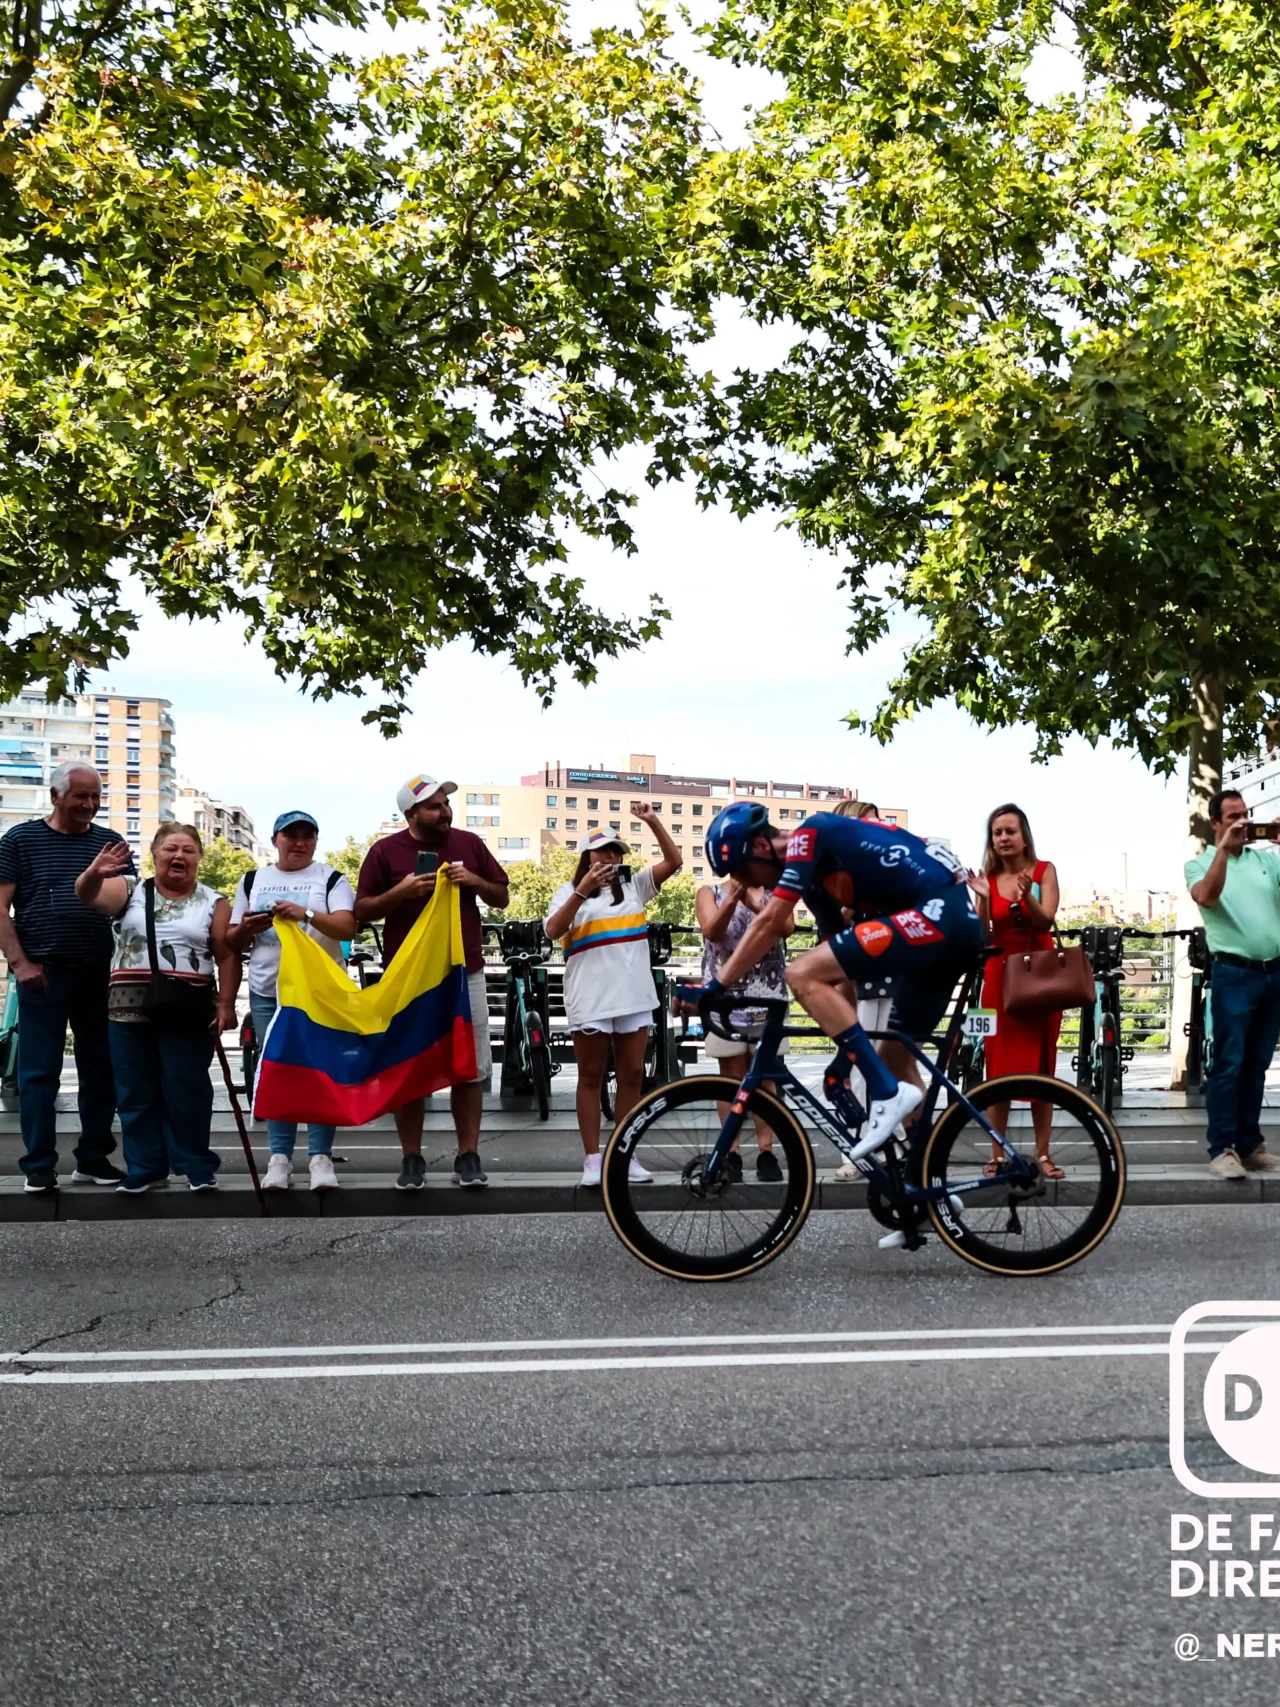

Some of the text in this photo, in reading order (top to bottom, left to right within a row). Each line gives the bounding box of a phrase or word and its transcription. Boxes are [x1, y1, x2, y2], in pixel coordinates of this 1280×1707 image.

[903, 856, 926, 875] more
[968, 1017, 990, 1033] 196
[618, 1097, 667, 1154] URSUS
[932, 1176, 964, 1239] URSS
